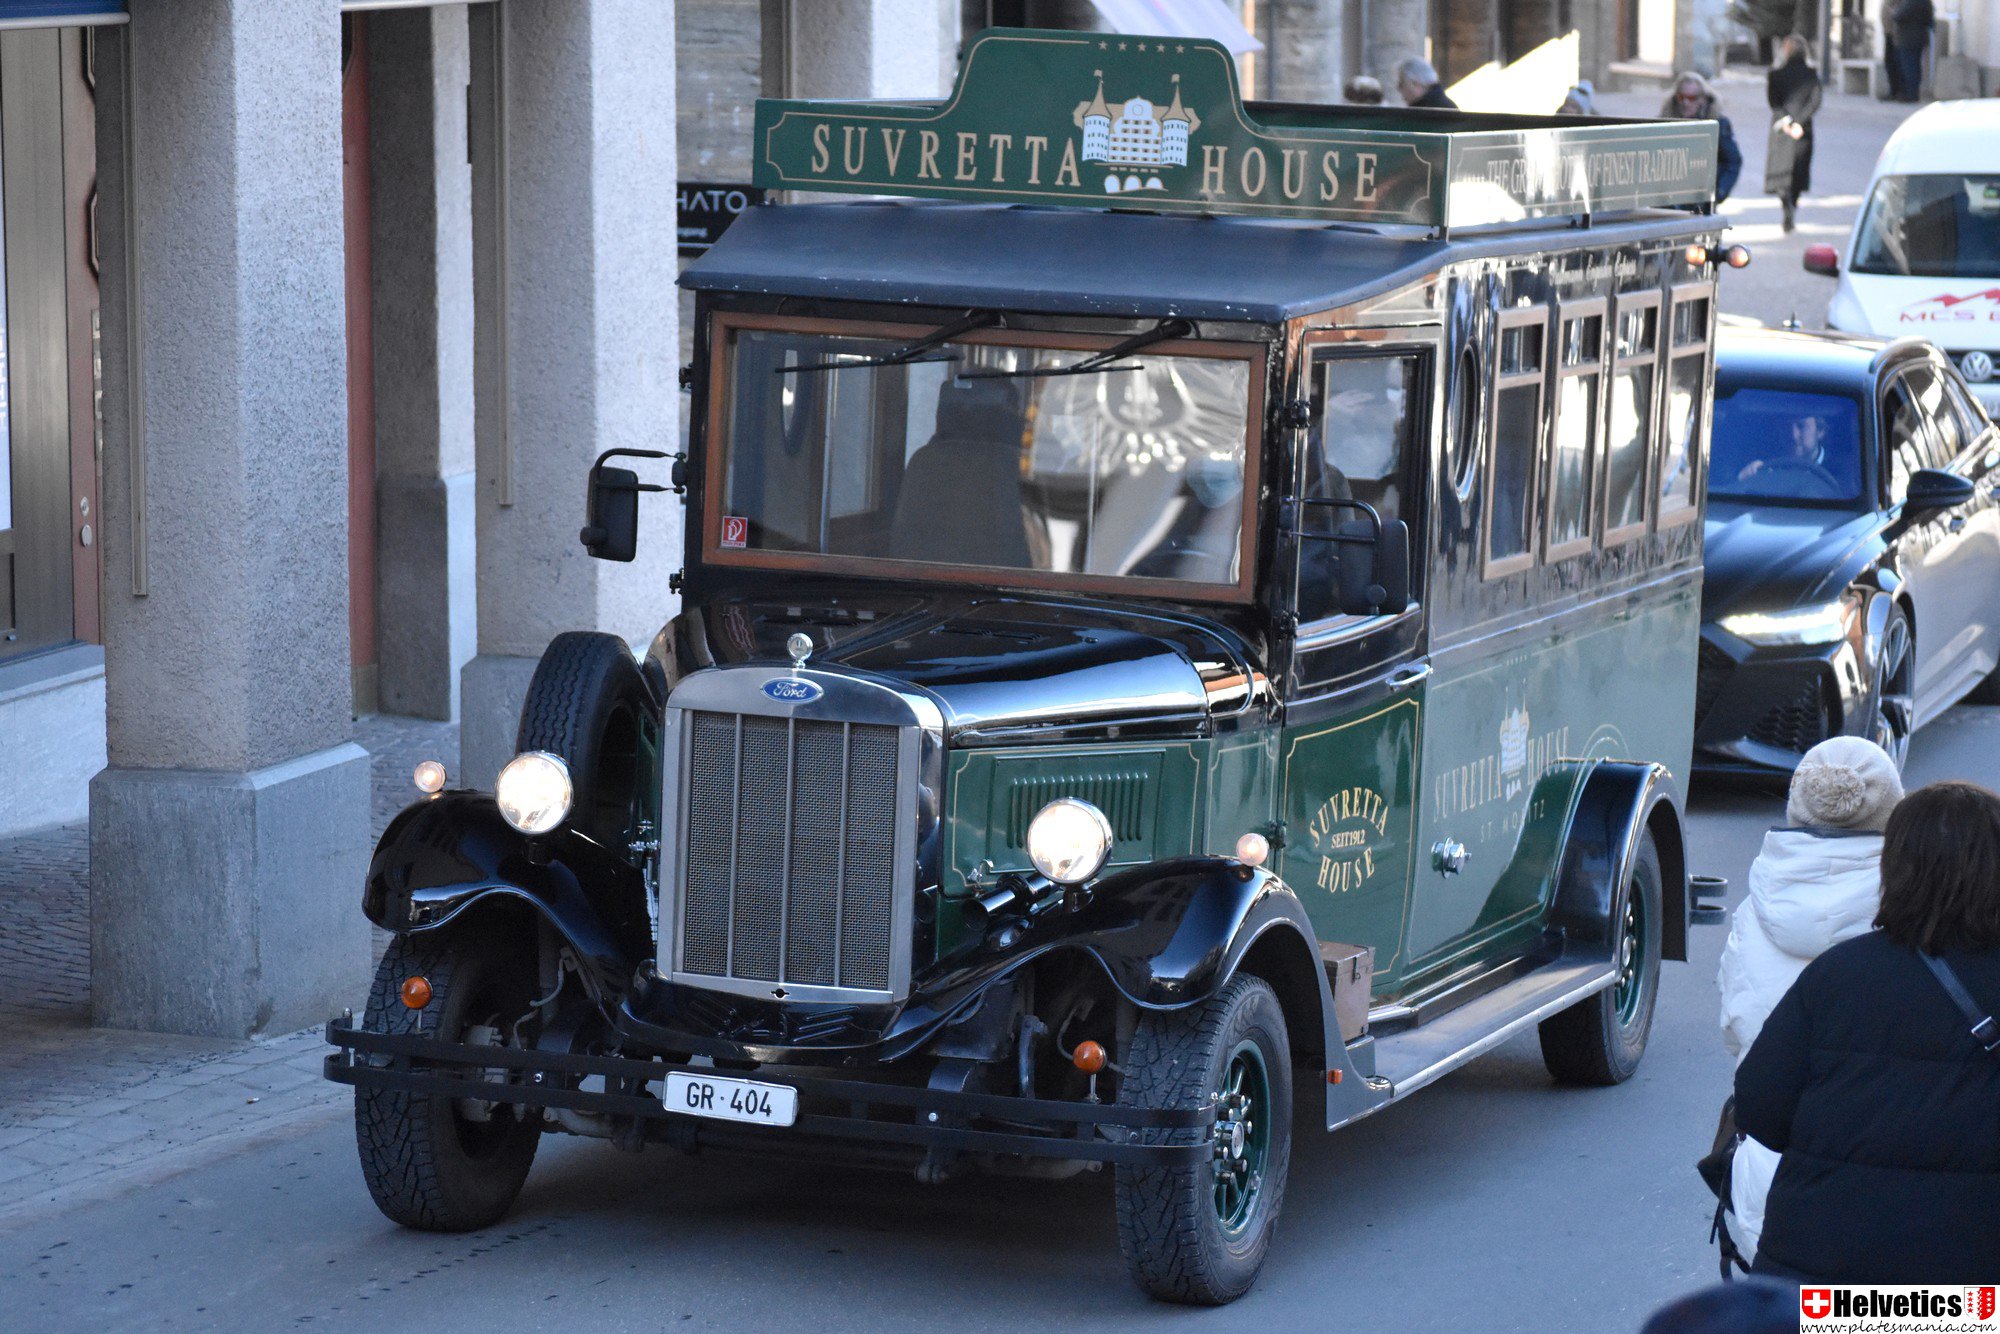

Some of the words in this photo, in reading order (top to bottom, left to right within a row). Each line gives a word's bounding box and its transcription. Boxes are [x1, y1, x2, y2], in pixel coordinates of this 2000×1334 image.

[811, 124, 1081, 187] SUVRETTA
[1201, 144, 1379, 202] HOUSE
[773, 681, 807, 698] Ford
[1433, 751, 1502, 823] SUVRETTA
[1527, 725, 1569, 786] HOUSE
[1309, 787, 1389, 848] SUVRETTA
[1317, 847, 1375, 893] HOUSE
